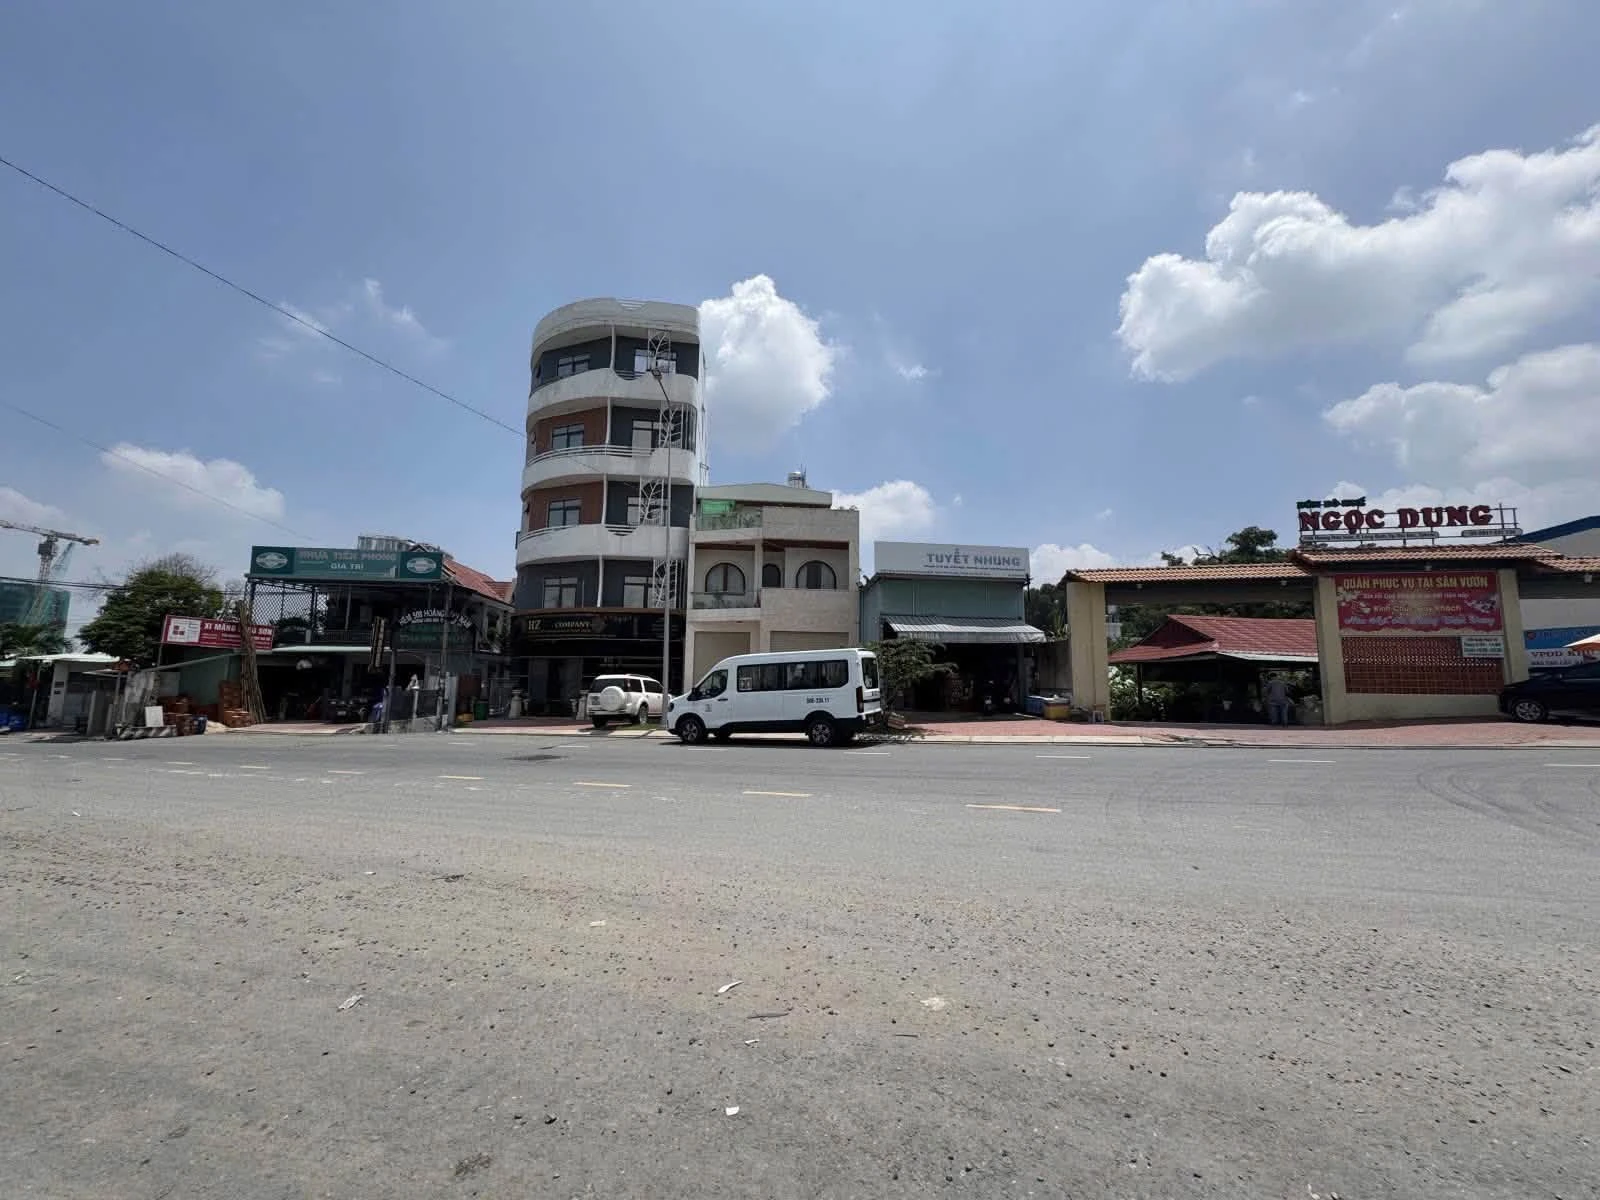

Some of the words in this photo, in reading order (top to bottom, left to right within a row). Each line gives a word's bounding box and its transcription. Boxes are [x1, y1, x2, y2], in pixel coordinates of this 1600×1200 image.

[1299, 509, 1385, 534] NGỌC
[1397, 505, 1493, 528] DUNG
[927, 547, 969, 565] TUYẾT
[974, 554, 1021, 569] NHUNG
[1343, 575, 1370, 590] QUÁN
[1401, 577, 1415, 591] VỤ
[1435, 574, 1458, 589] SÂN
